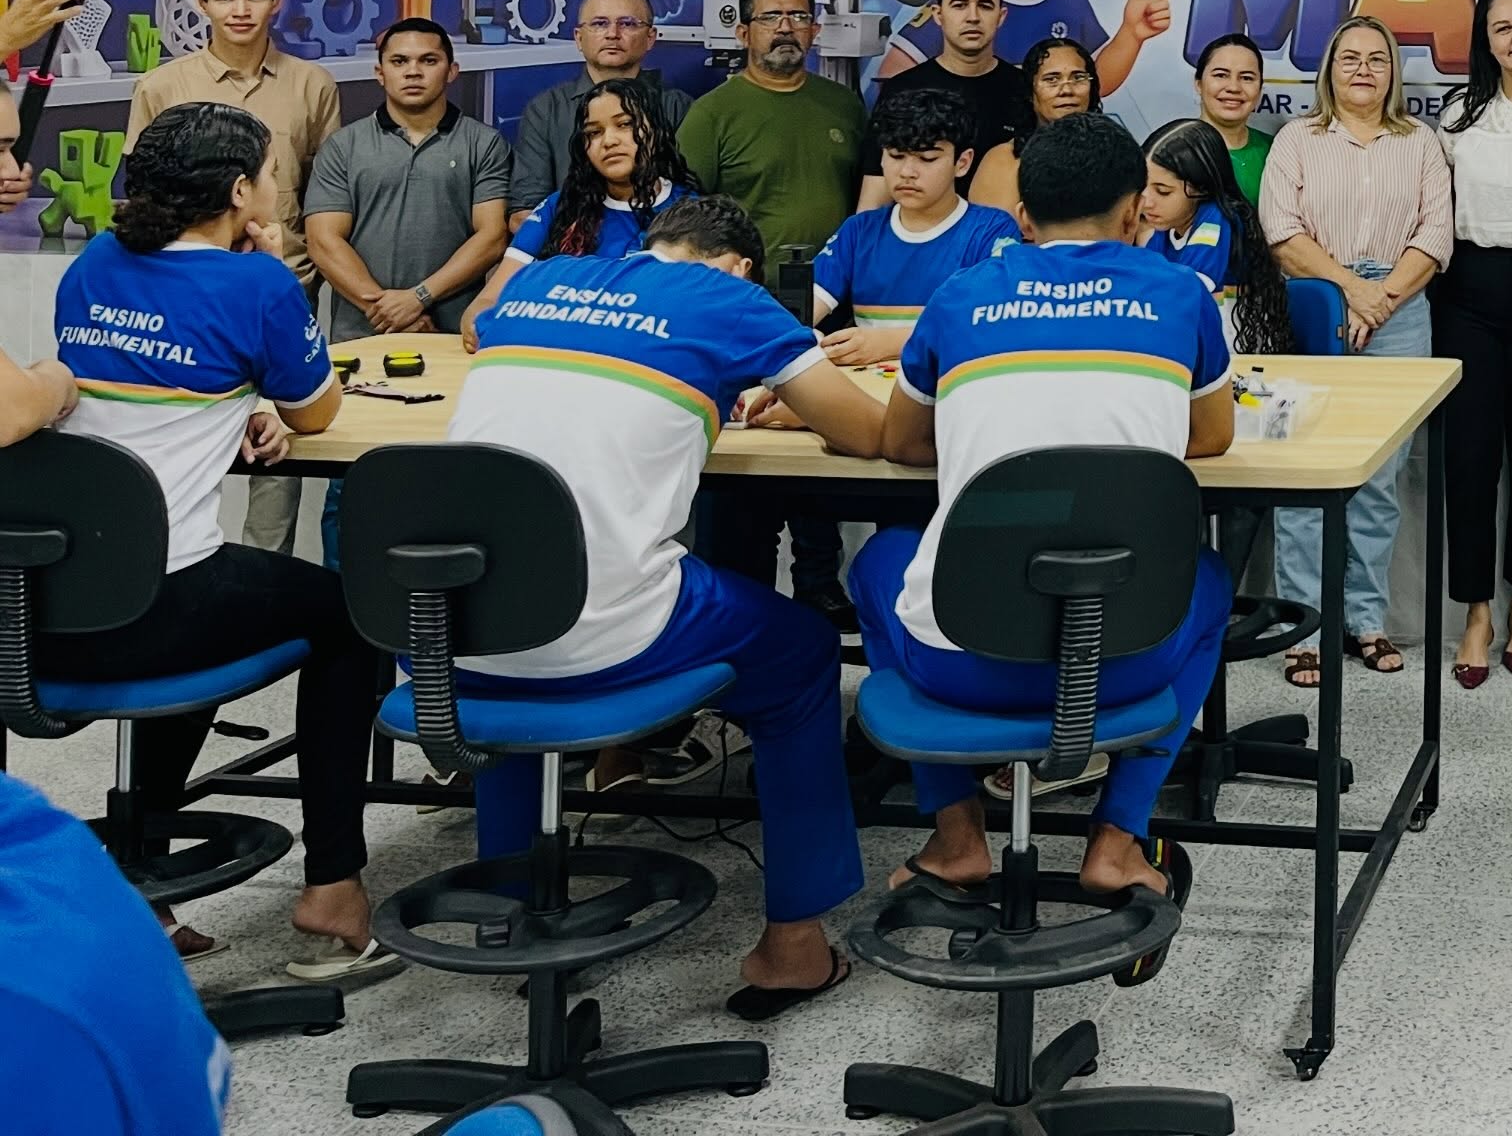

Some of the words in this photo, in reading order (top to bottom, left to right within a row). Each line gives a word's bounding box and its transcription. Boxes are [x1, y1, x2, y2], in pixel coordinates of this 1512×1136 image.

[1251, 94, 1292, 114] AR
[1407, 97, 1441, 116] DE
[546, 284, 638, 308] ENSINO
[1017, 278, 1112, 300] ENSINO
[90, 304, 164, 333] ENSINO
[495, 300, 671, 339] FUNDAMENTAL
[972, 299, 1159, 325] FUNDAMENTAL
[59, 326, 197, 366] FUNDAMENTAL
